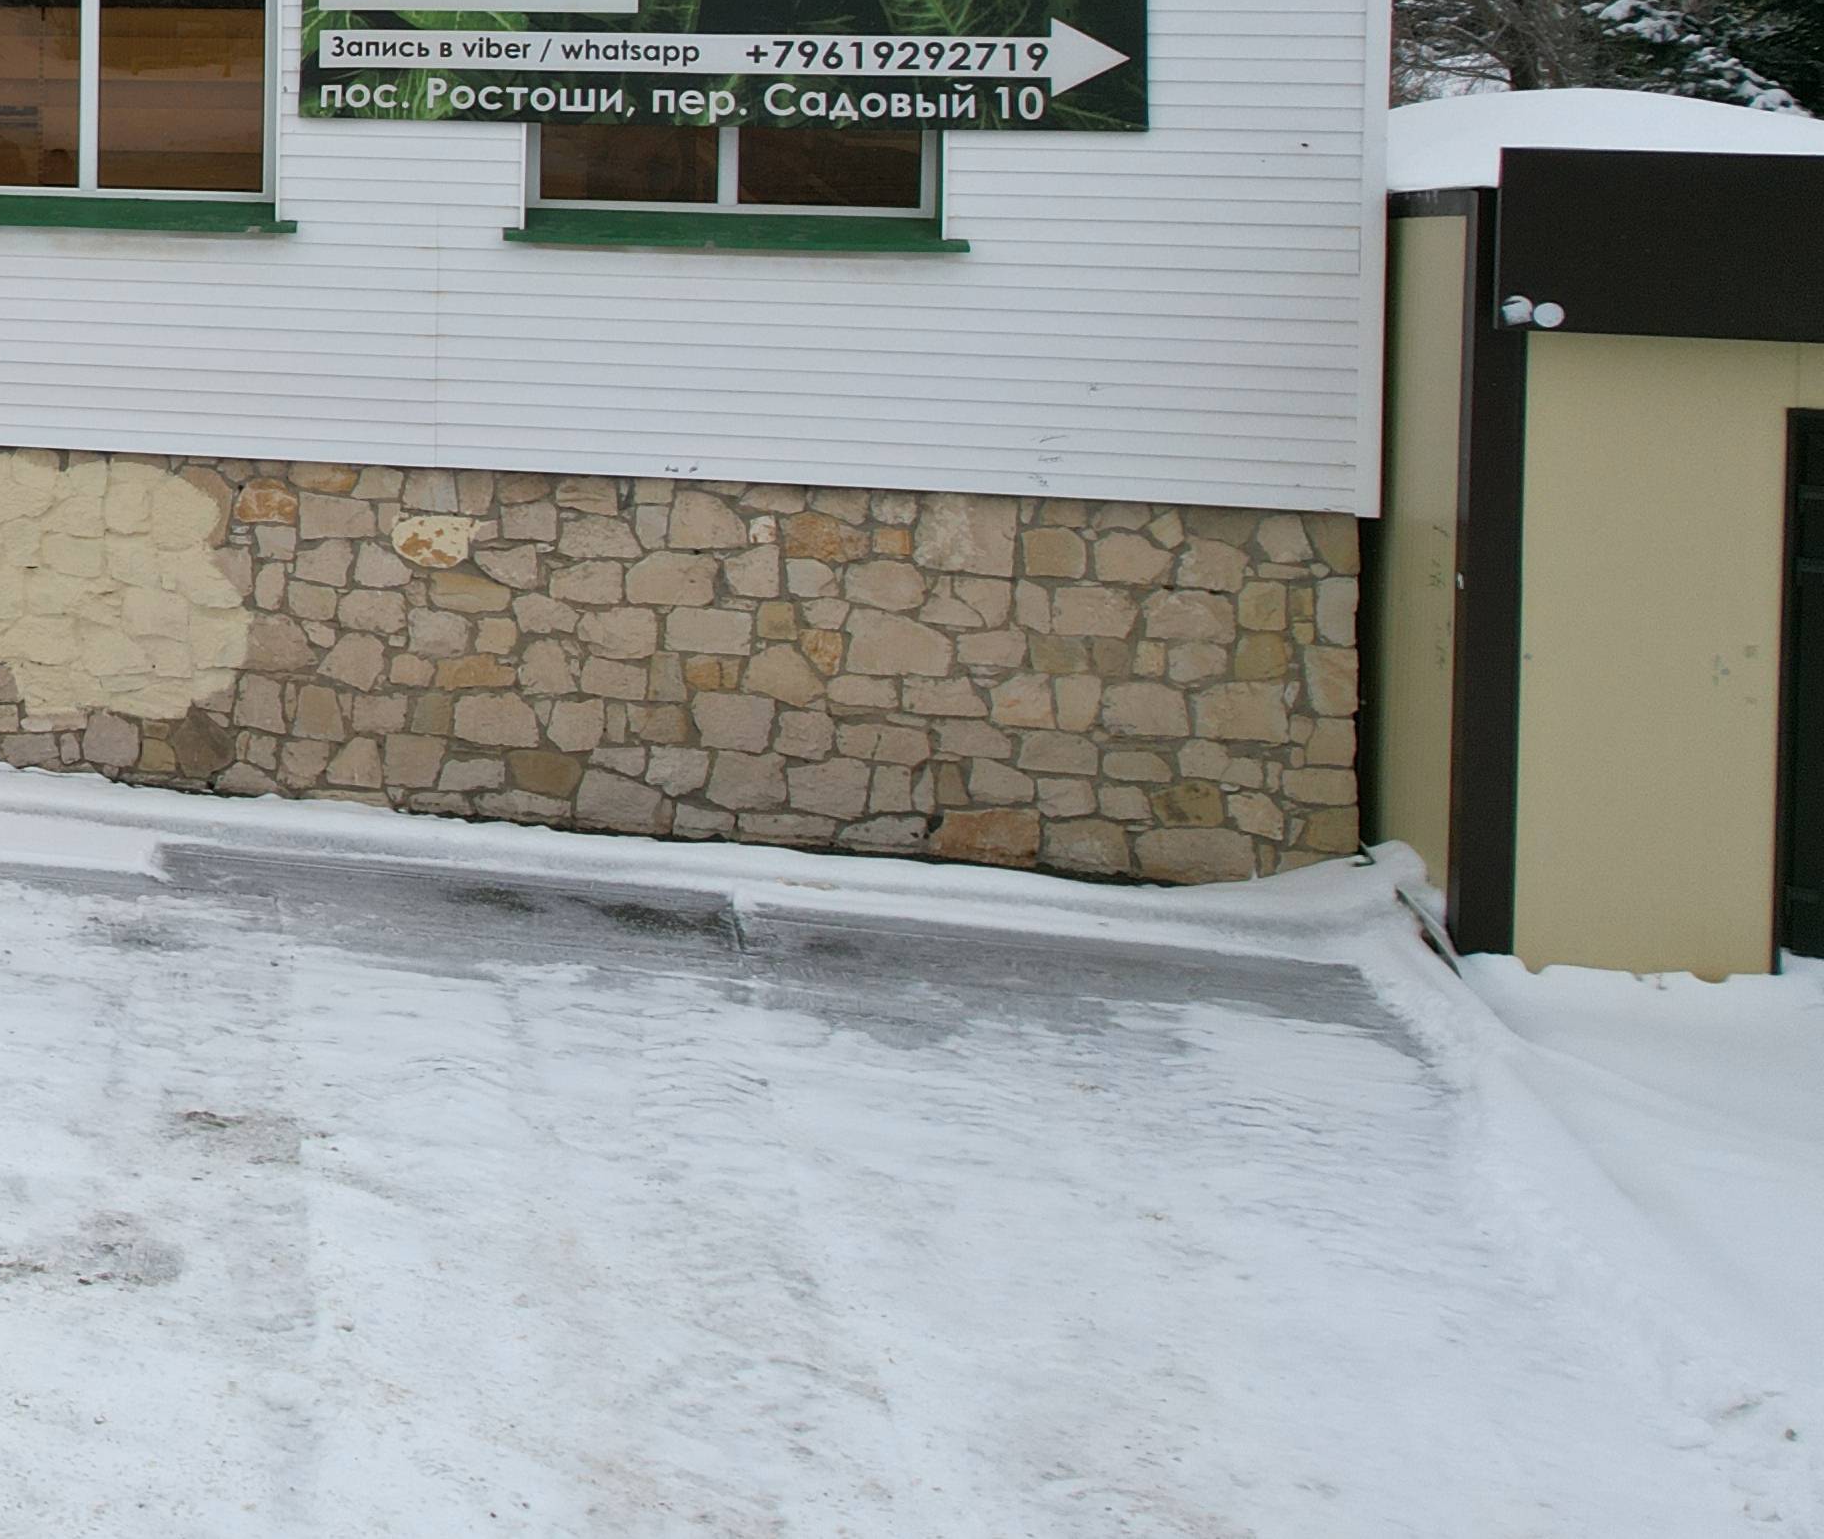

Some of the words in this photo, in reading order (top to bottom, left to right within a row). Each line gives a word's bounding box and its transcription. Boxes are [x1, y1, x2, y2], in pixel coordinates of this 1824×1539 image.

[330, 35, 430, 58] Запись
[439, 42, 453, 58] в
[462, 37, 532, 60] viber
[561, 39, 701, 66] whatsapp
[745, 40, 1049, 72] +79619292719
[320, 81, 410, 110] пос.
[426, 77, 636, 118] Ростоши,
[652, 87, 748, 123] пер.
[762, 82, 976, 121] Садовый
[994, 86, 1044, 120] 10
